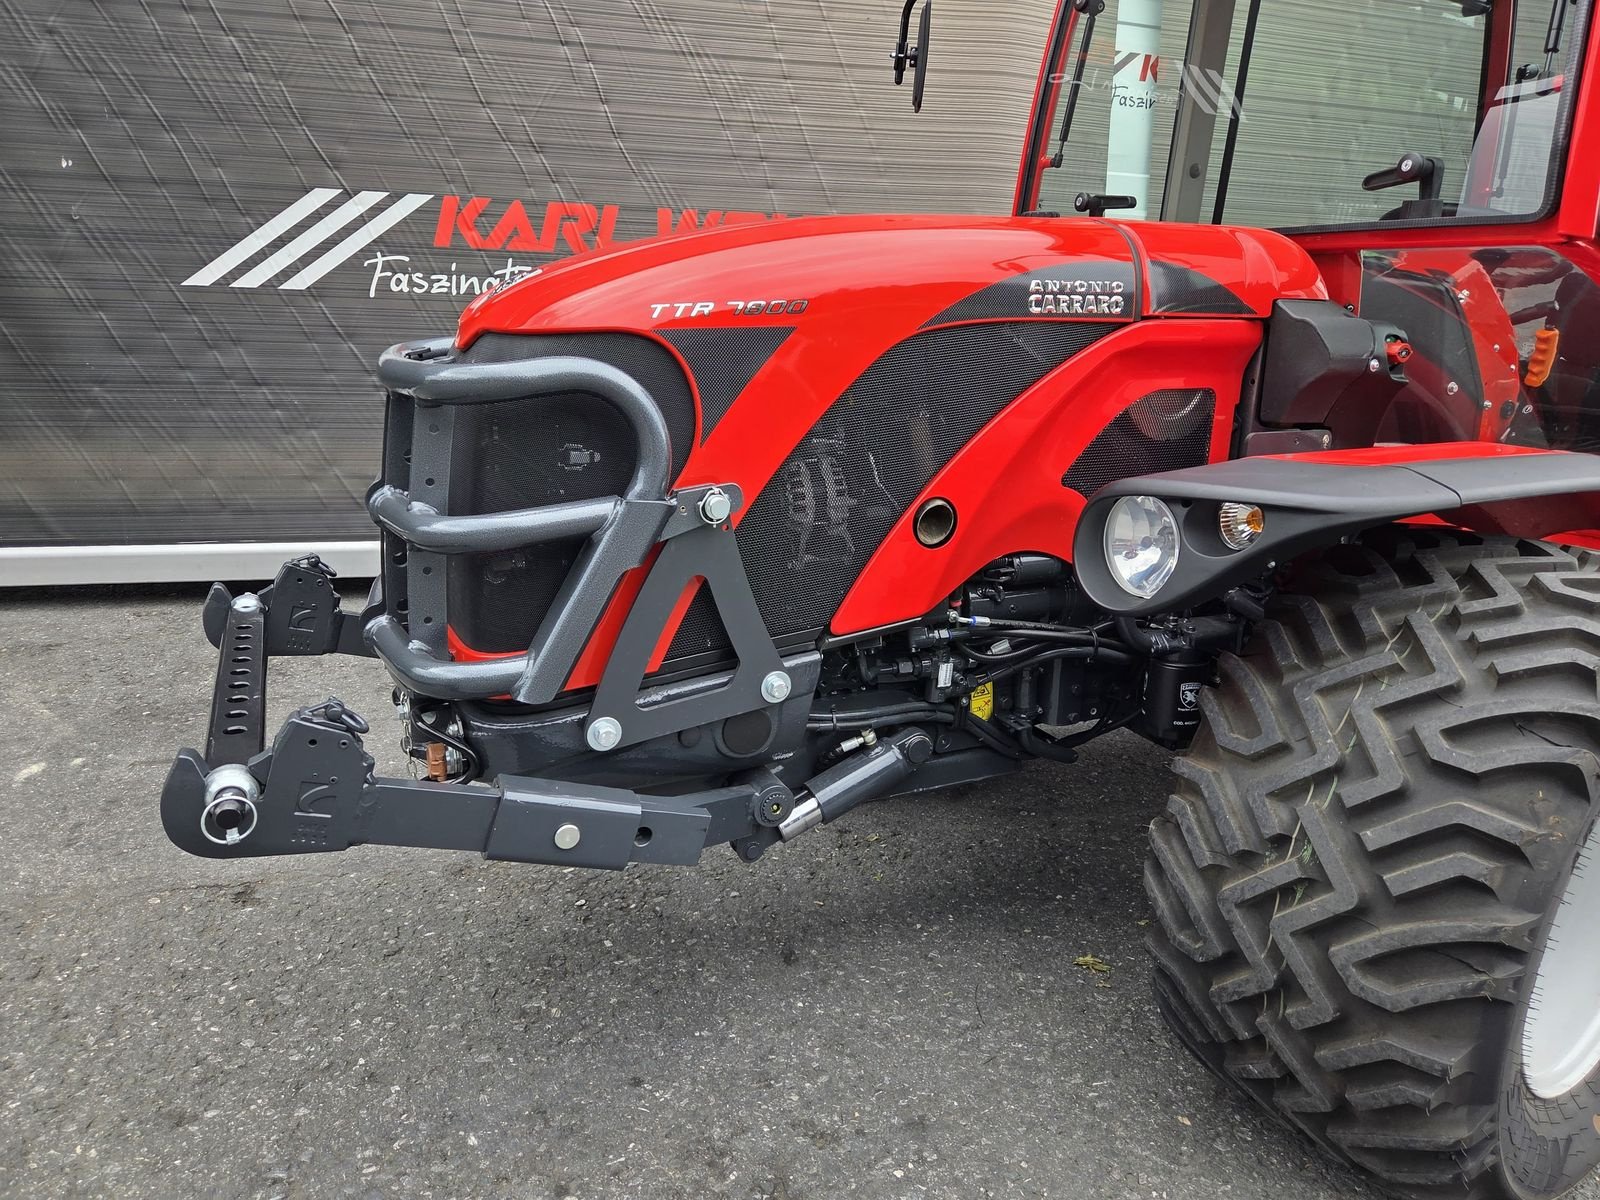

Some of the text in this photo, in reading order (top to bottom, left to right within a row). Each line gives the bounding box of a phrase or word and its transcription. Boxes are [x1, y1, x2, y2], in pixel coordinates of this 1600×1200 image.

[433, 195, 622, 254] KARL
[363, 251, 532, 298] Faszinat
[1029, 280, 1124, 293] ANTONIO
[650, 300, 808, 319] TTR 7800
[1028, 294, 1124, 314] CARRARO
